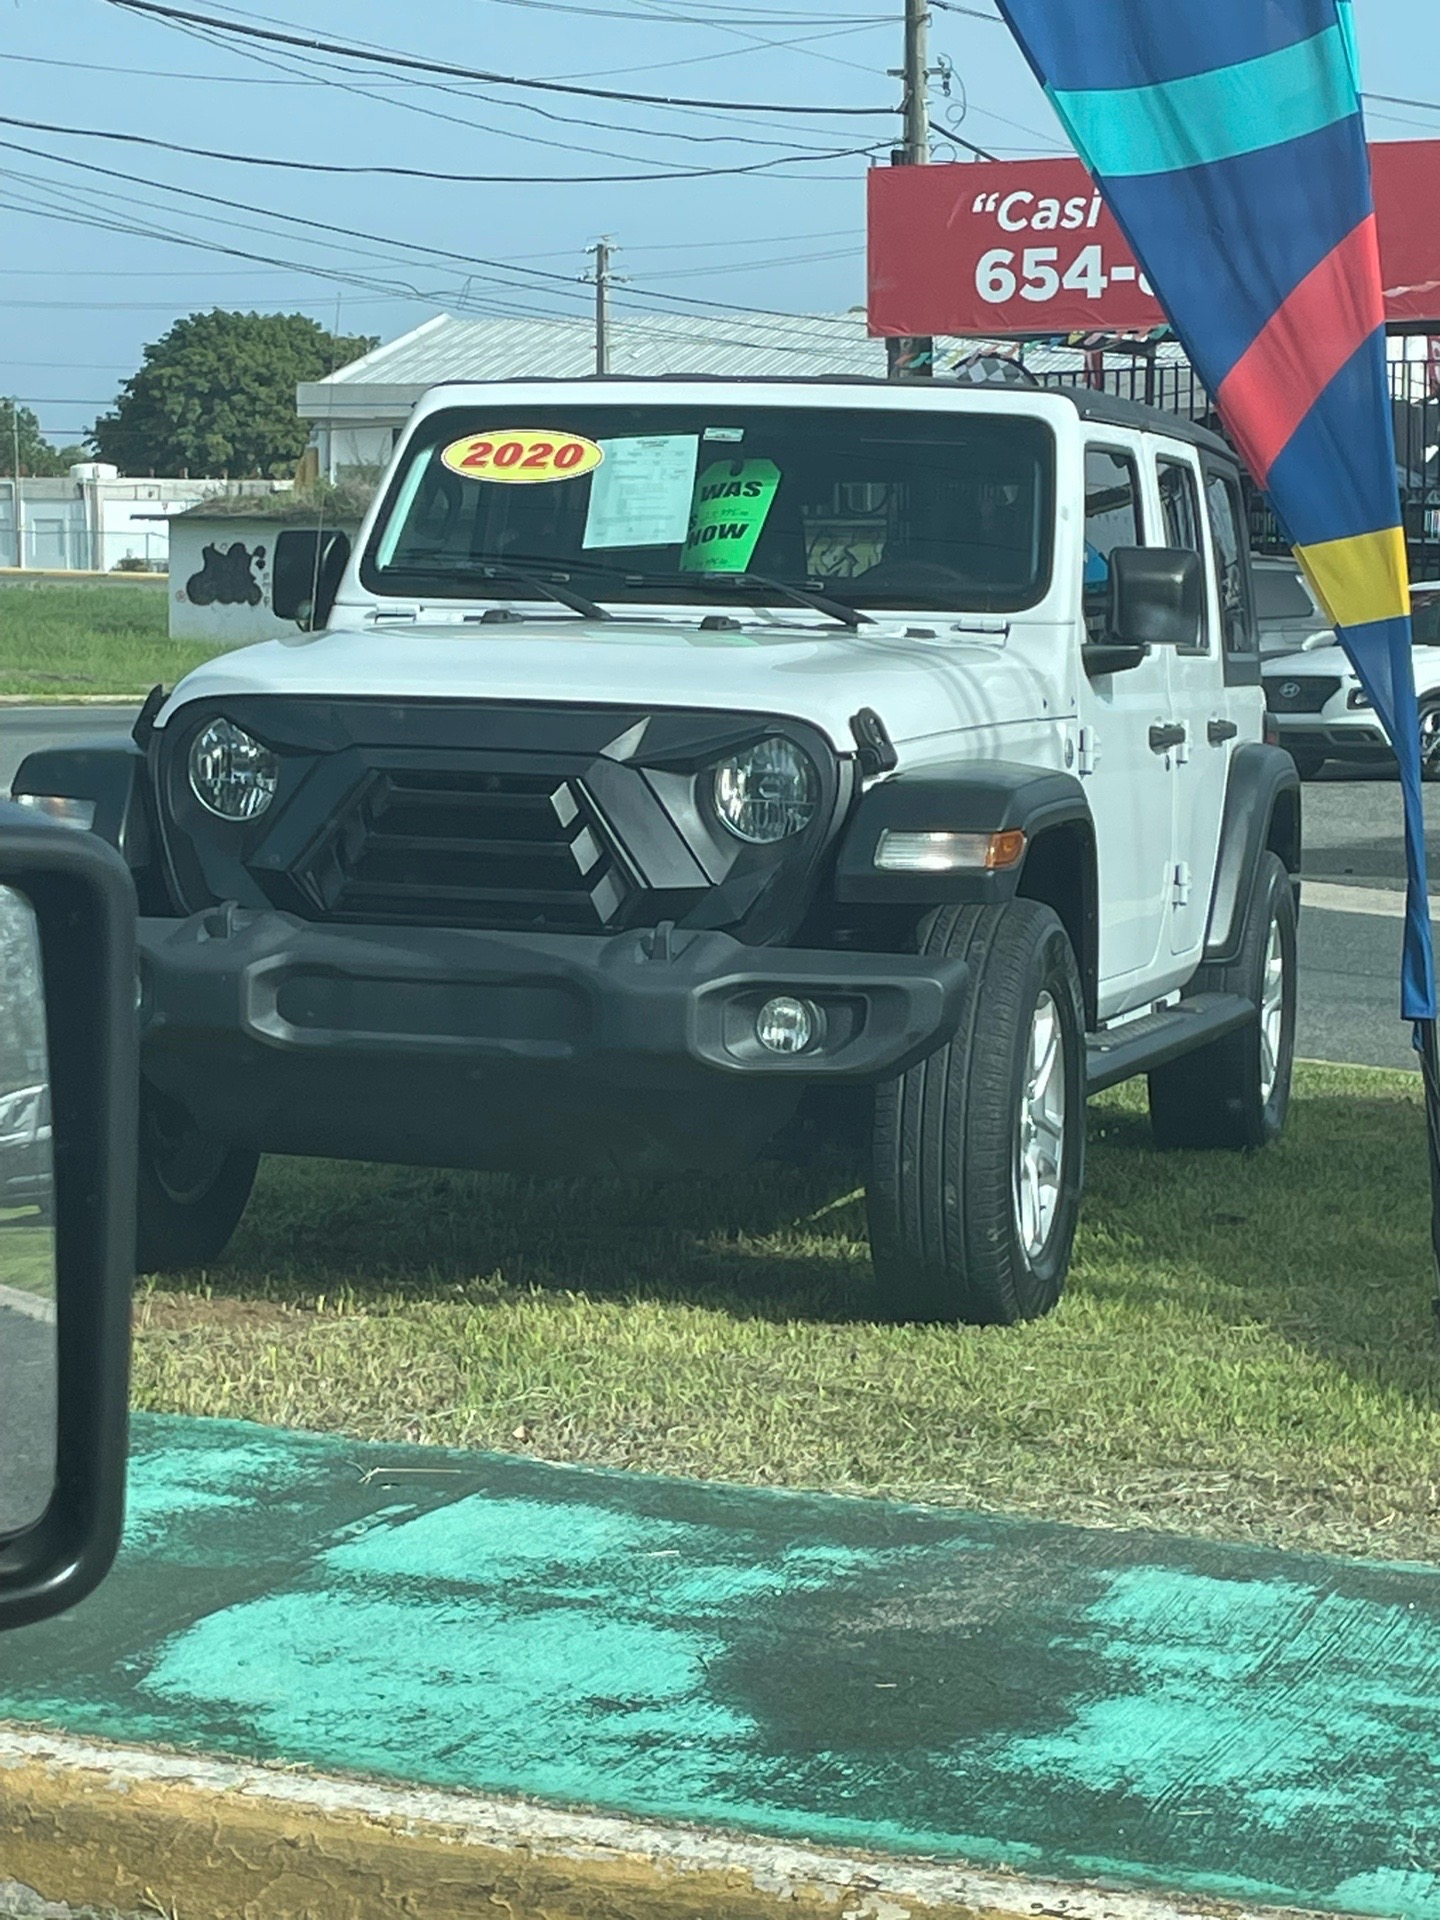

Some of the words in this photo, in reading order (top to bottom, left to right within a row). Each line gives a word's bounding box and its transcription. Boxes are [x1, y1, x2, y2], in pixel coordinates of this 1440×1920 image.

[460, 442, 585, 470] 2020
[701, 481, 763, 502] WAS
[688, 523, 750, 549] NOW
